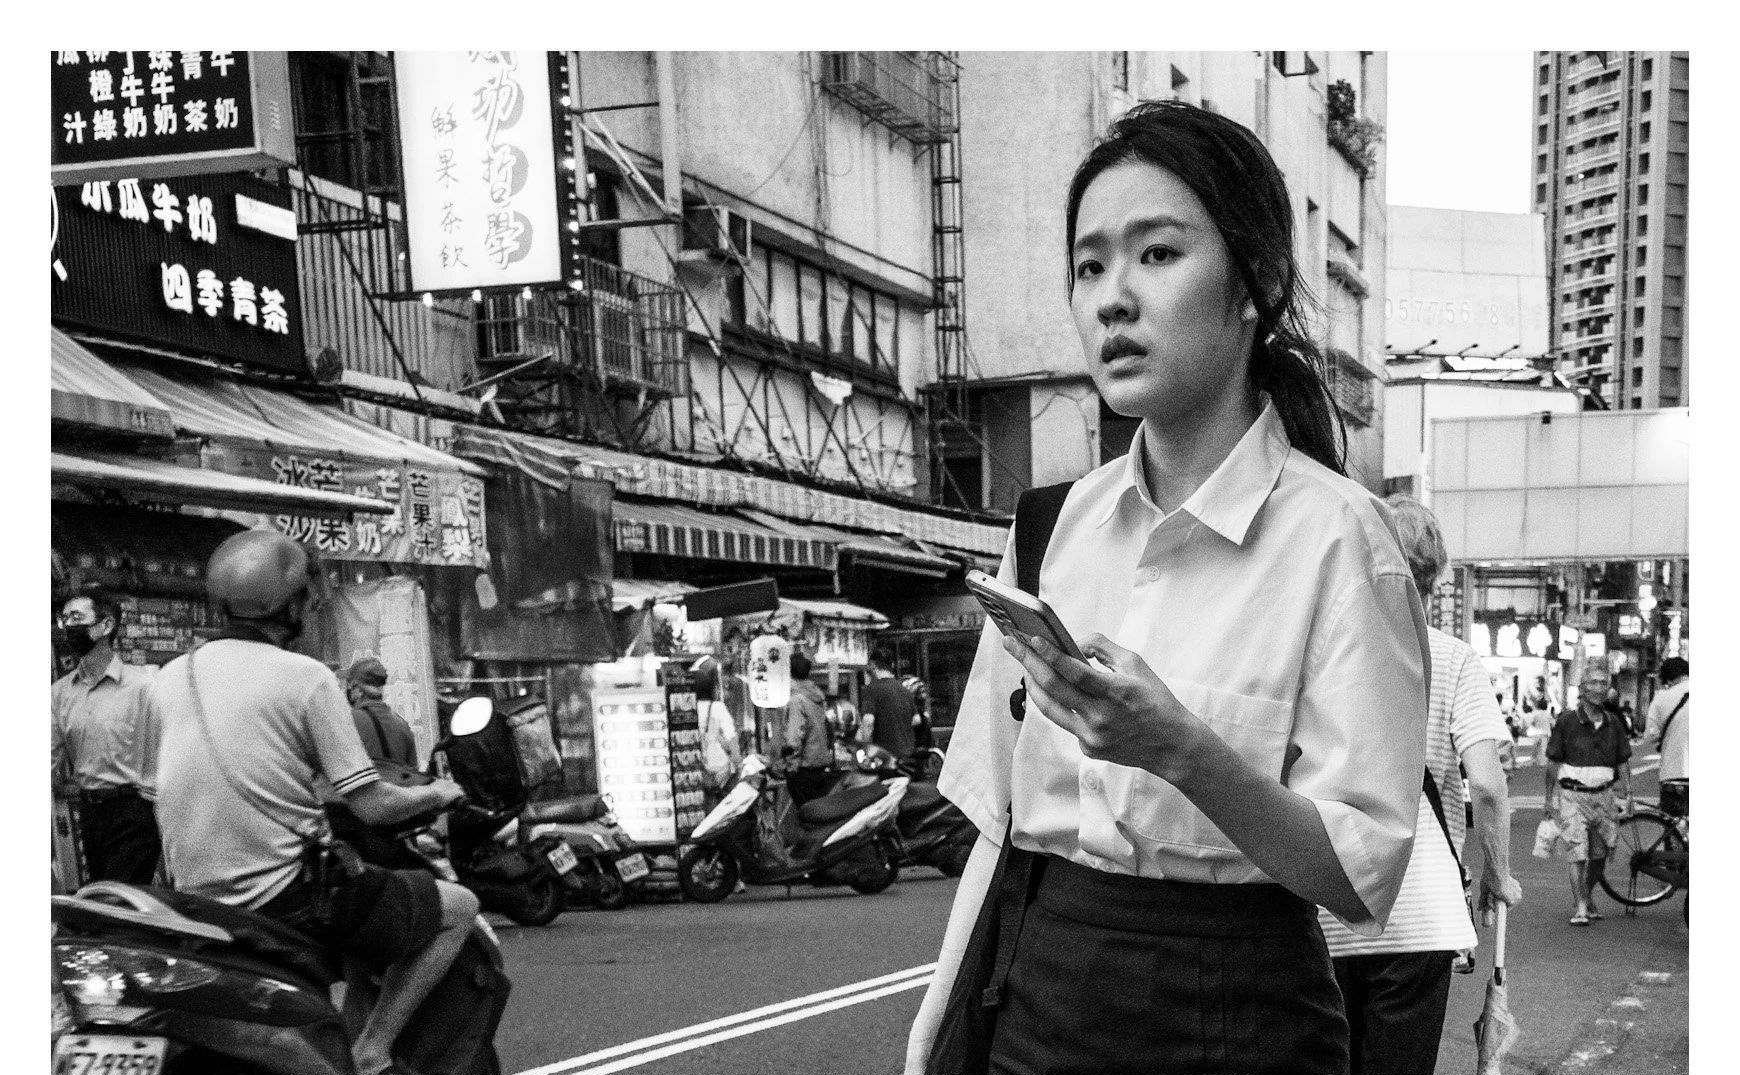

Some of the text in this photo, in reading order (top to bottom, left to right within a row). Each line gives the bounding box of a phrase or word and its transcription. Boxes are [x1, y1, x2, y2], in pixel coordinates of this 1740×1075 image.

[431, 103, 468, 268] 鮮果茶飲
[161, 262, 289, 335] 四季青茶
